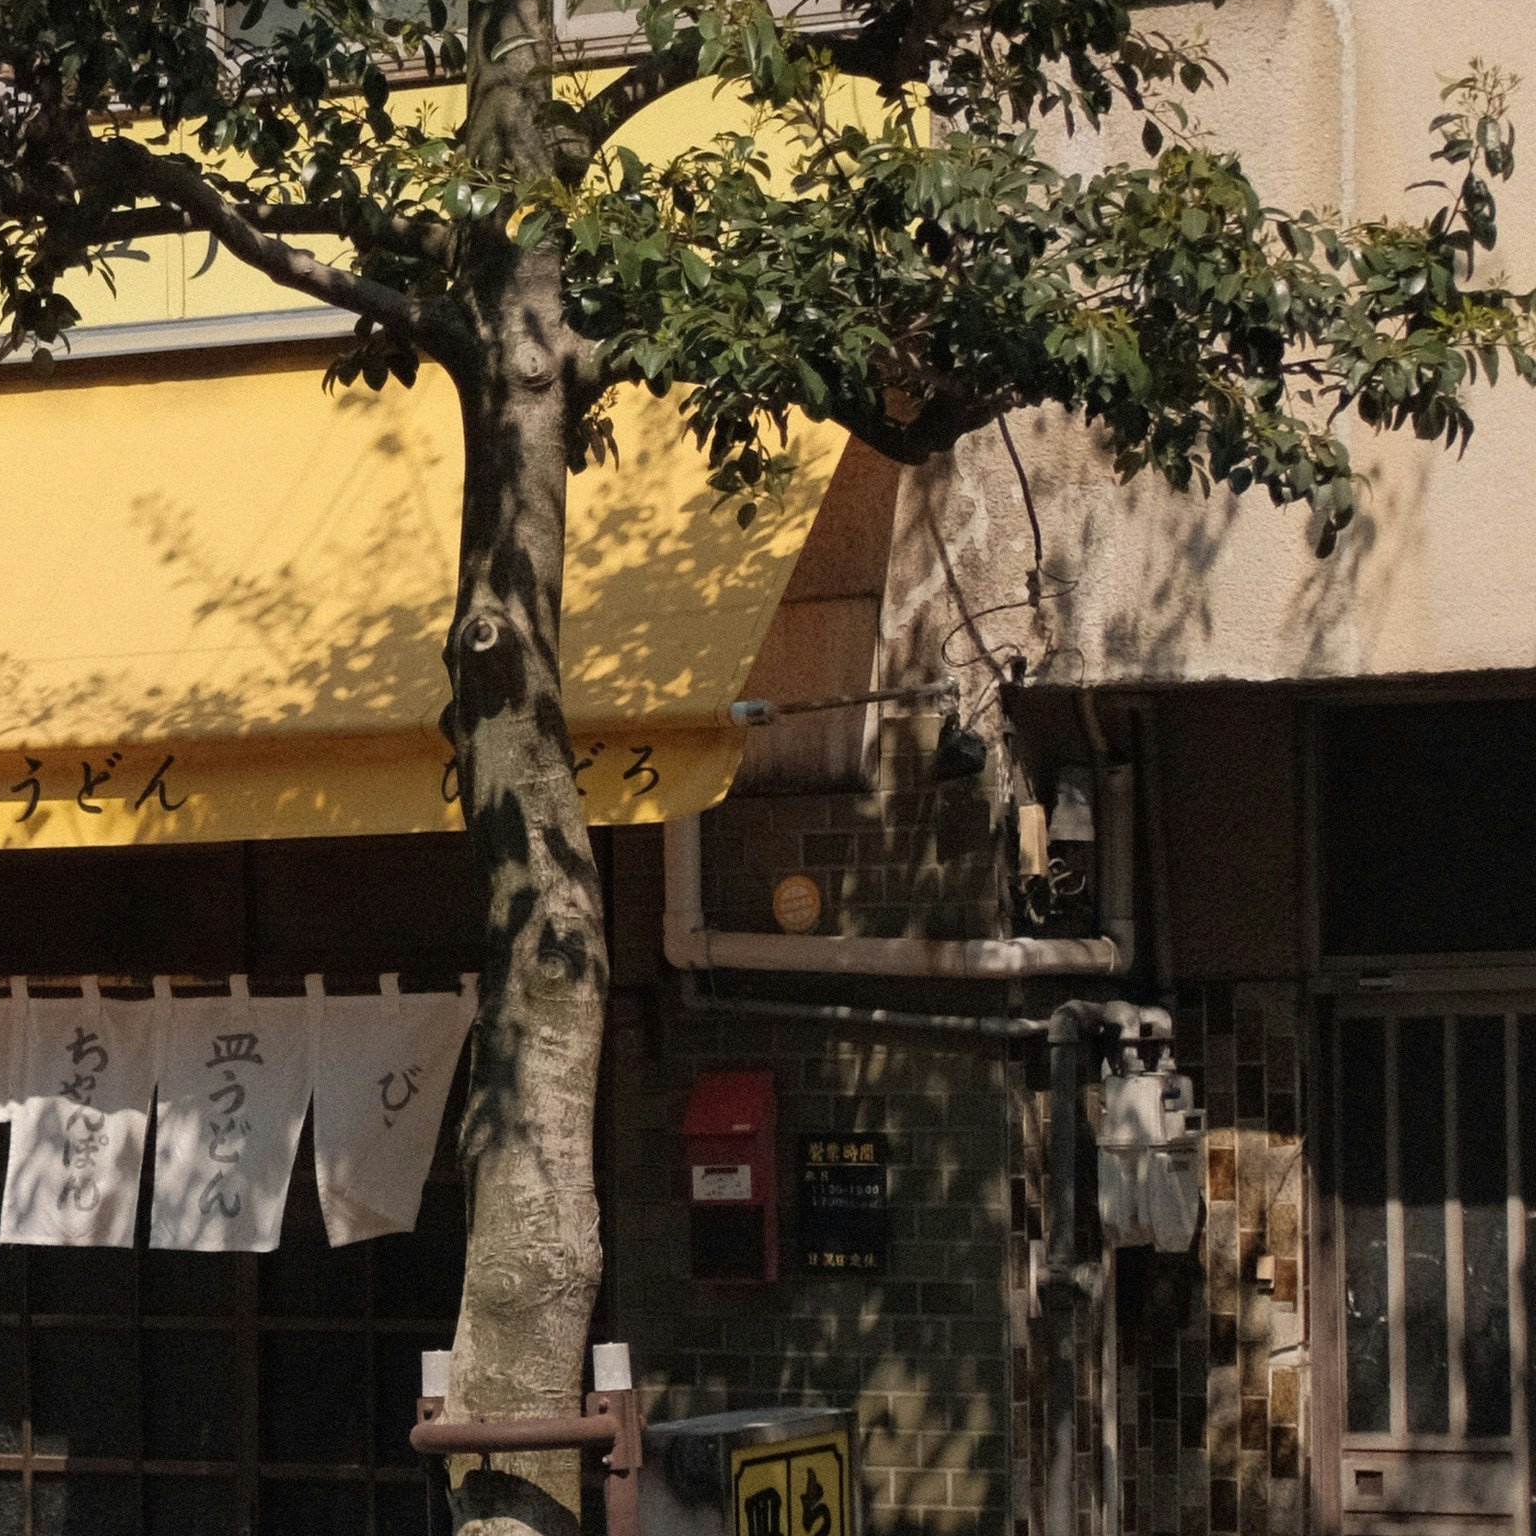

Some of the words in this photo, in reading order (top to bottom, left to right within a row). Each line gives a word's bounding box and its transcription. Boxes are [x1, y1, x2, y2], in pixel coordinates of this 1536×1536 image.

[59, 1026, 110, 1213] ちゃんぽん
[199, 1033, 265, 1220] 皿うどん
